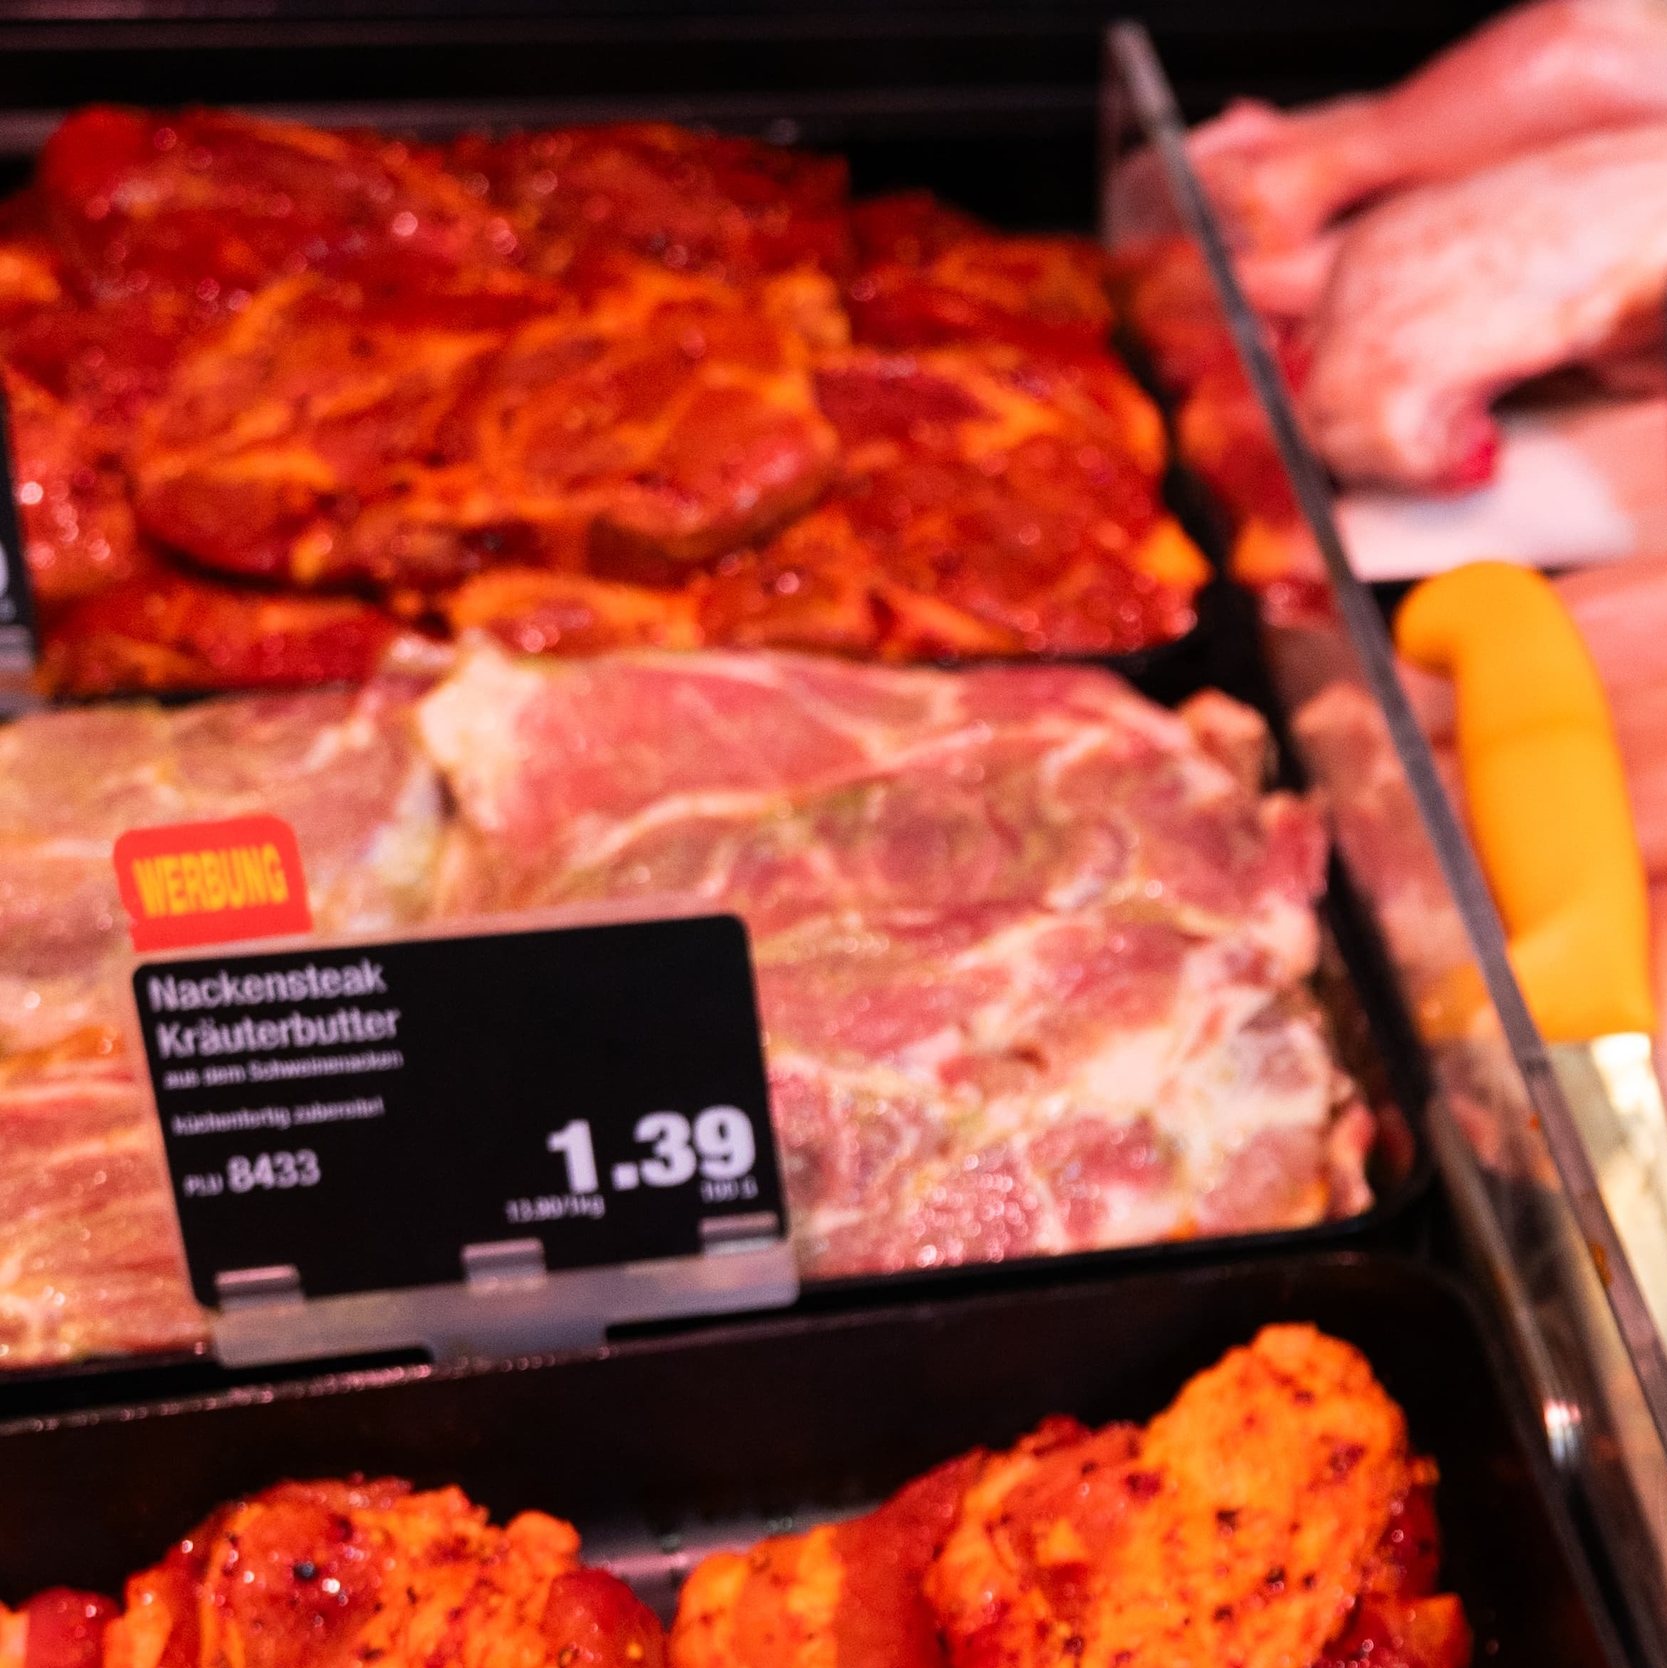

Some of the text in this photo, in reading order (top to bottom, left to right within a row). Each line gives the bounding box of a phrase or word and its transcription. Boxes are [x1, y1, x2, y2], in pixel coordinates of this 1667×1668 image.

[131, 843, 290, 919] WERBUNG
[147, 958, 388, 1013] Nackensteak
[155, 1006, 401, 1060] Kräuterbutter
[182, 1148, 322, 1198] PLU 8433
[546, 1103, 757, 1195] 1.39
